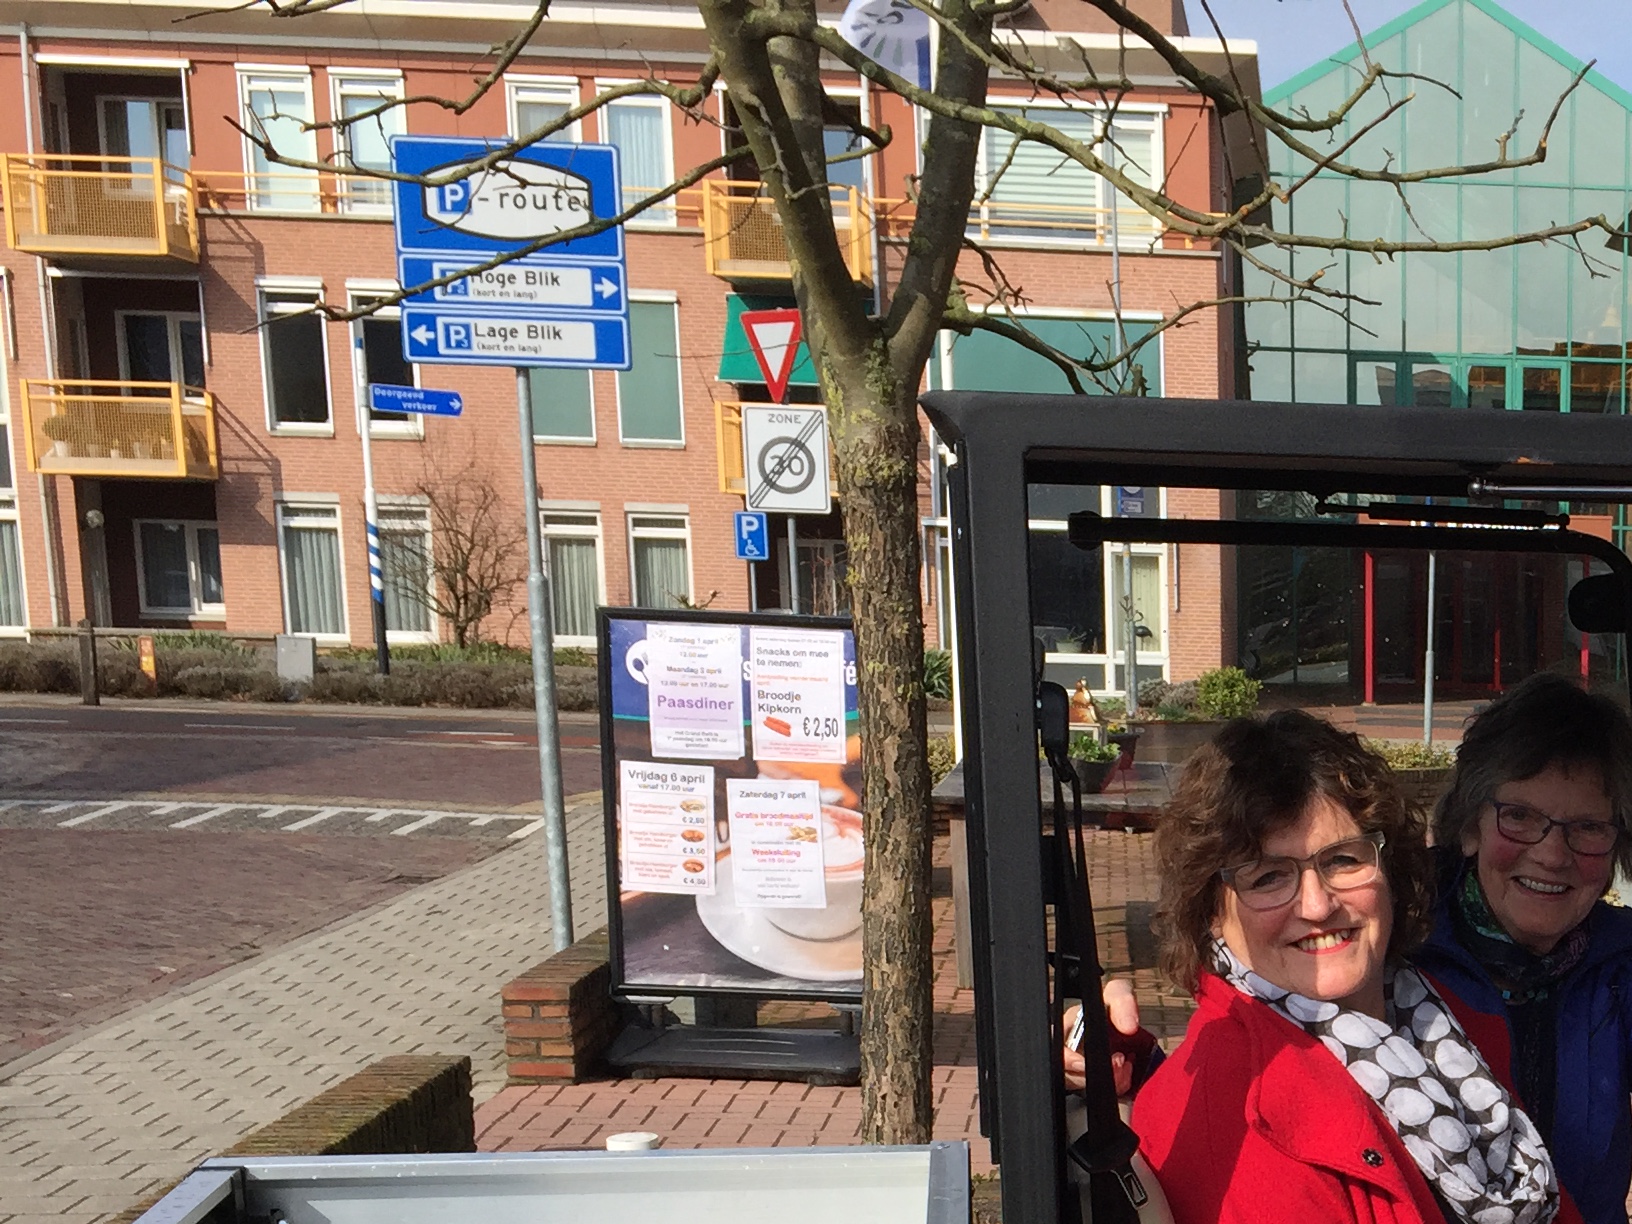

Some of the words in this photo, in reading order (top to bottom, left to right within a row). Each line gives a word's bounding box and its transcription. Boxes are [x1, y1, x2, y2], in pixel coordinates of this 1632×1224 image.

[470, 269, 517, 288] Hoge
[525, 271, 561, 287] Blik
[473, 289, 495, 298] (kort
[499, 290, 510, 298] en
[514, 290, 537, 299] lang)
[474, 323, 519, 342] Lage
[527, 325, 563, 340] Blik
[477, 342, 500, 351] (kort
[518, 344, 542, 354] lang)
[768, 413, 802, 424] ZONE
[741, 516, 759, 539] P
[756, 647, 790, 656] Snacks
[809, 650, 829, 658] mee
[756, 658, 765, 666] te
[657, 695, 734, 710] Paasdiner
[757, 690, 801, 703] Broodje
[758, 703, 801, 714] Kipkorn
[803, 717, 811, 737] €
[813, 718, 838, 740] 2,50
[628, 769, 668, 783] Vrijdag
[680, 774, 705, 784] april
[739, 791, 778, 800] Zaterdag
